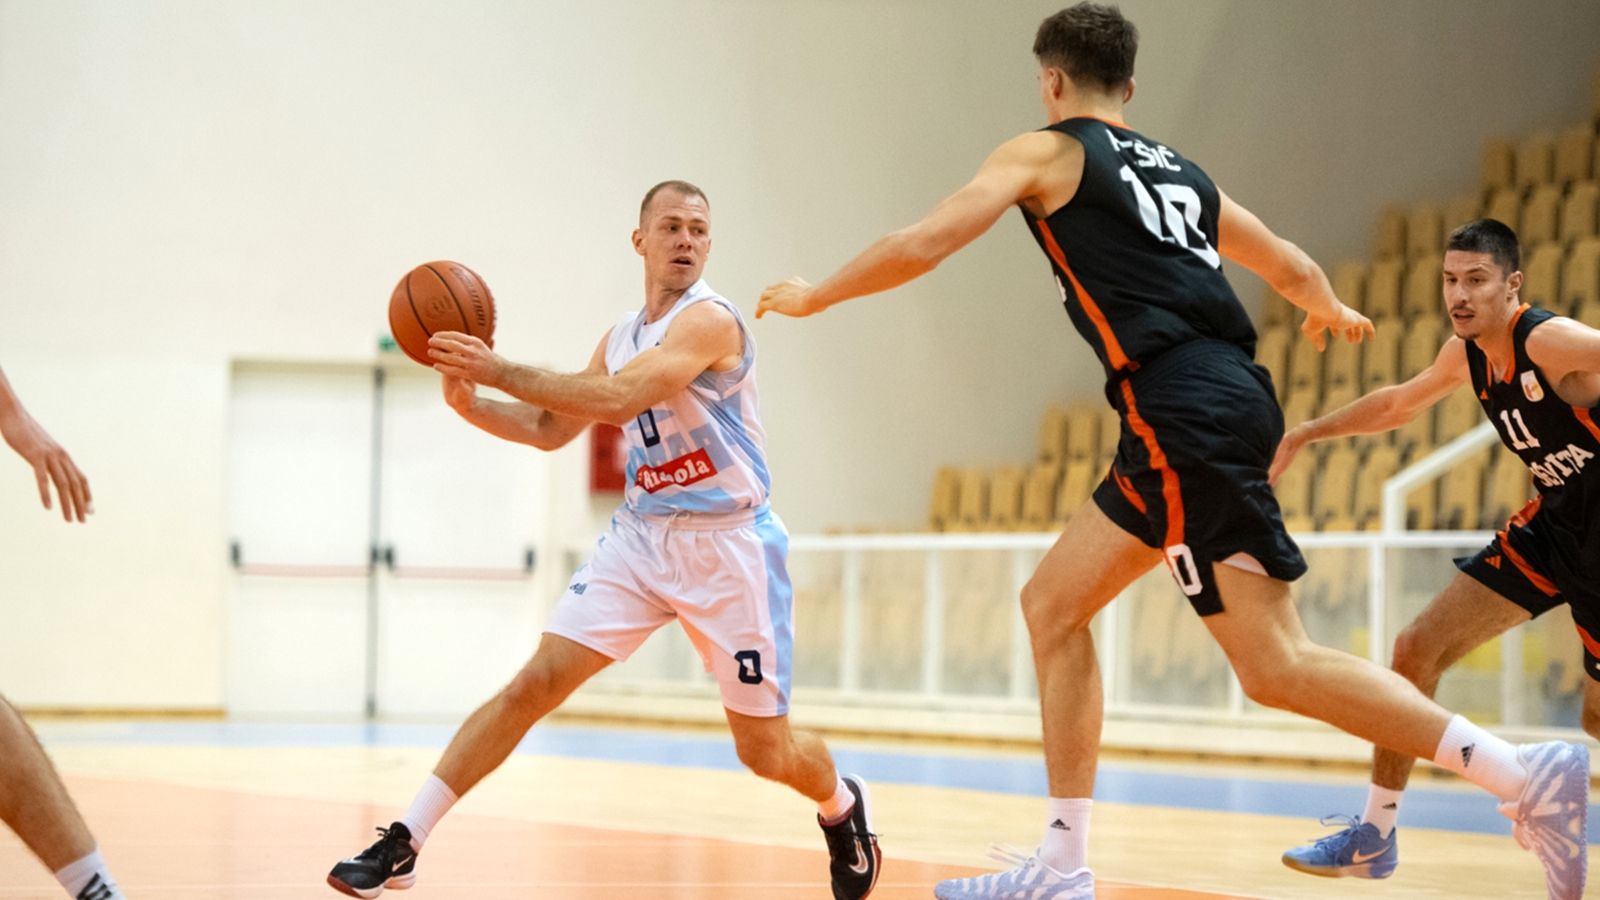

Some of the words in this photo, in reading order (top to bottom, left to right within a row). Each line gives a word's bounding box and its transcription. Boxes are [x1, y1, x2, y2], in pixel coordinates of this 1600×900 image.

[1119, 164, 1221, 270] 10
[636, 407, 660, 448] 0
[1500, 408, 1540, 450] 11
[734, 649, 763, 685] 0
